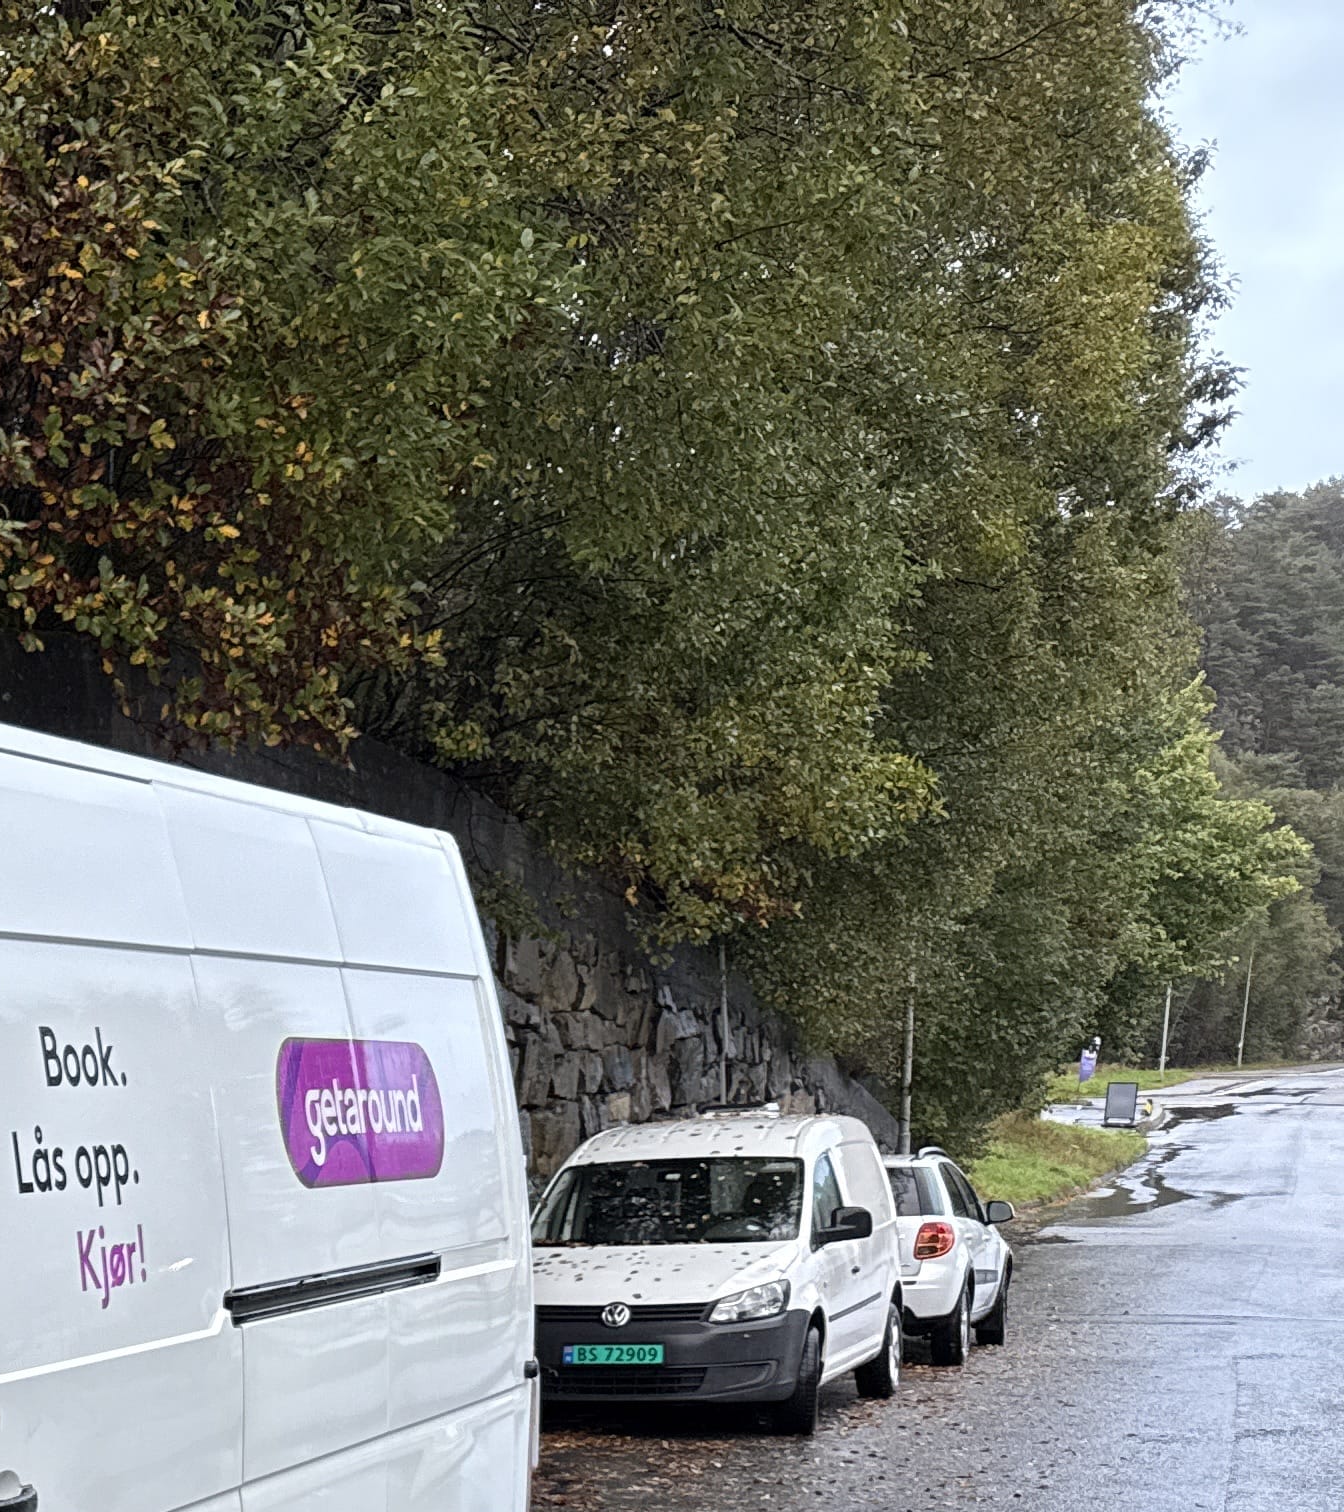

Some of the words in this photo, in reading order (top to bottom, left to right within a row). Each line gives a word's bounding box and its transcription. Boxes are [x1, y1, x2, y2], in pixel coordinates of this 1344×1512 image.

[38, 1025, 127, 1087] Book.
[305, 1074, 423, 1166] getaround
[11, 1125, 67, 1194] Lås
[75, 1142, 139, 1207] opp.
[76, 1224, 147, 1309] Kjør!
[577, 1347, 598, 1362] BS
[604, 1347, 658, 1362] 72909
